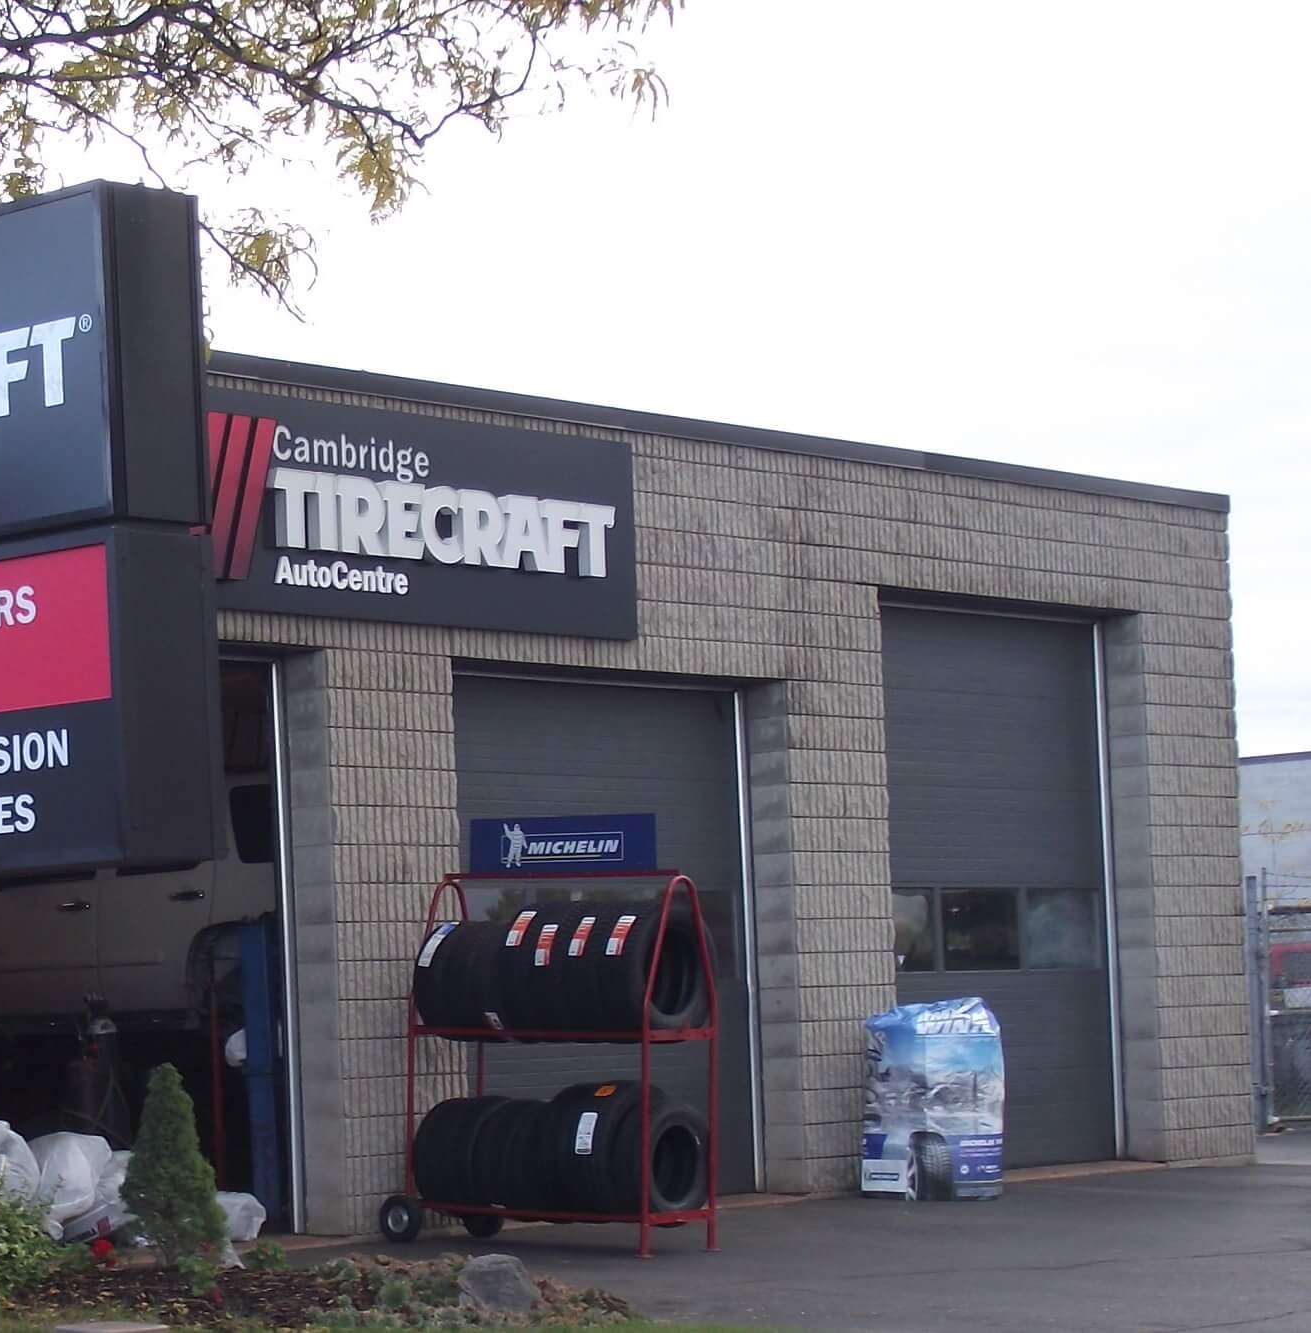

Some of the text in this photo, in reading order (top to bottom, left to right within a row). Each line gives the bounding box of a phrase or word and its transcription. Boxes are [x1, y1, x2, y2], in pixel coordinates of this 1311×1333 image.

[272, 425, 431, 483] Cambridge
[267, 467, 616, 578] TIRECRAFT
[274, 555, 409, 595] AutoCentre
[527, 839, 620, 855] MICHELIN
